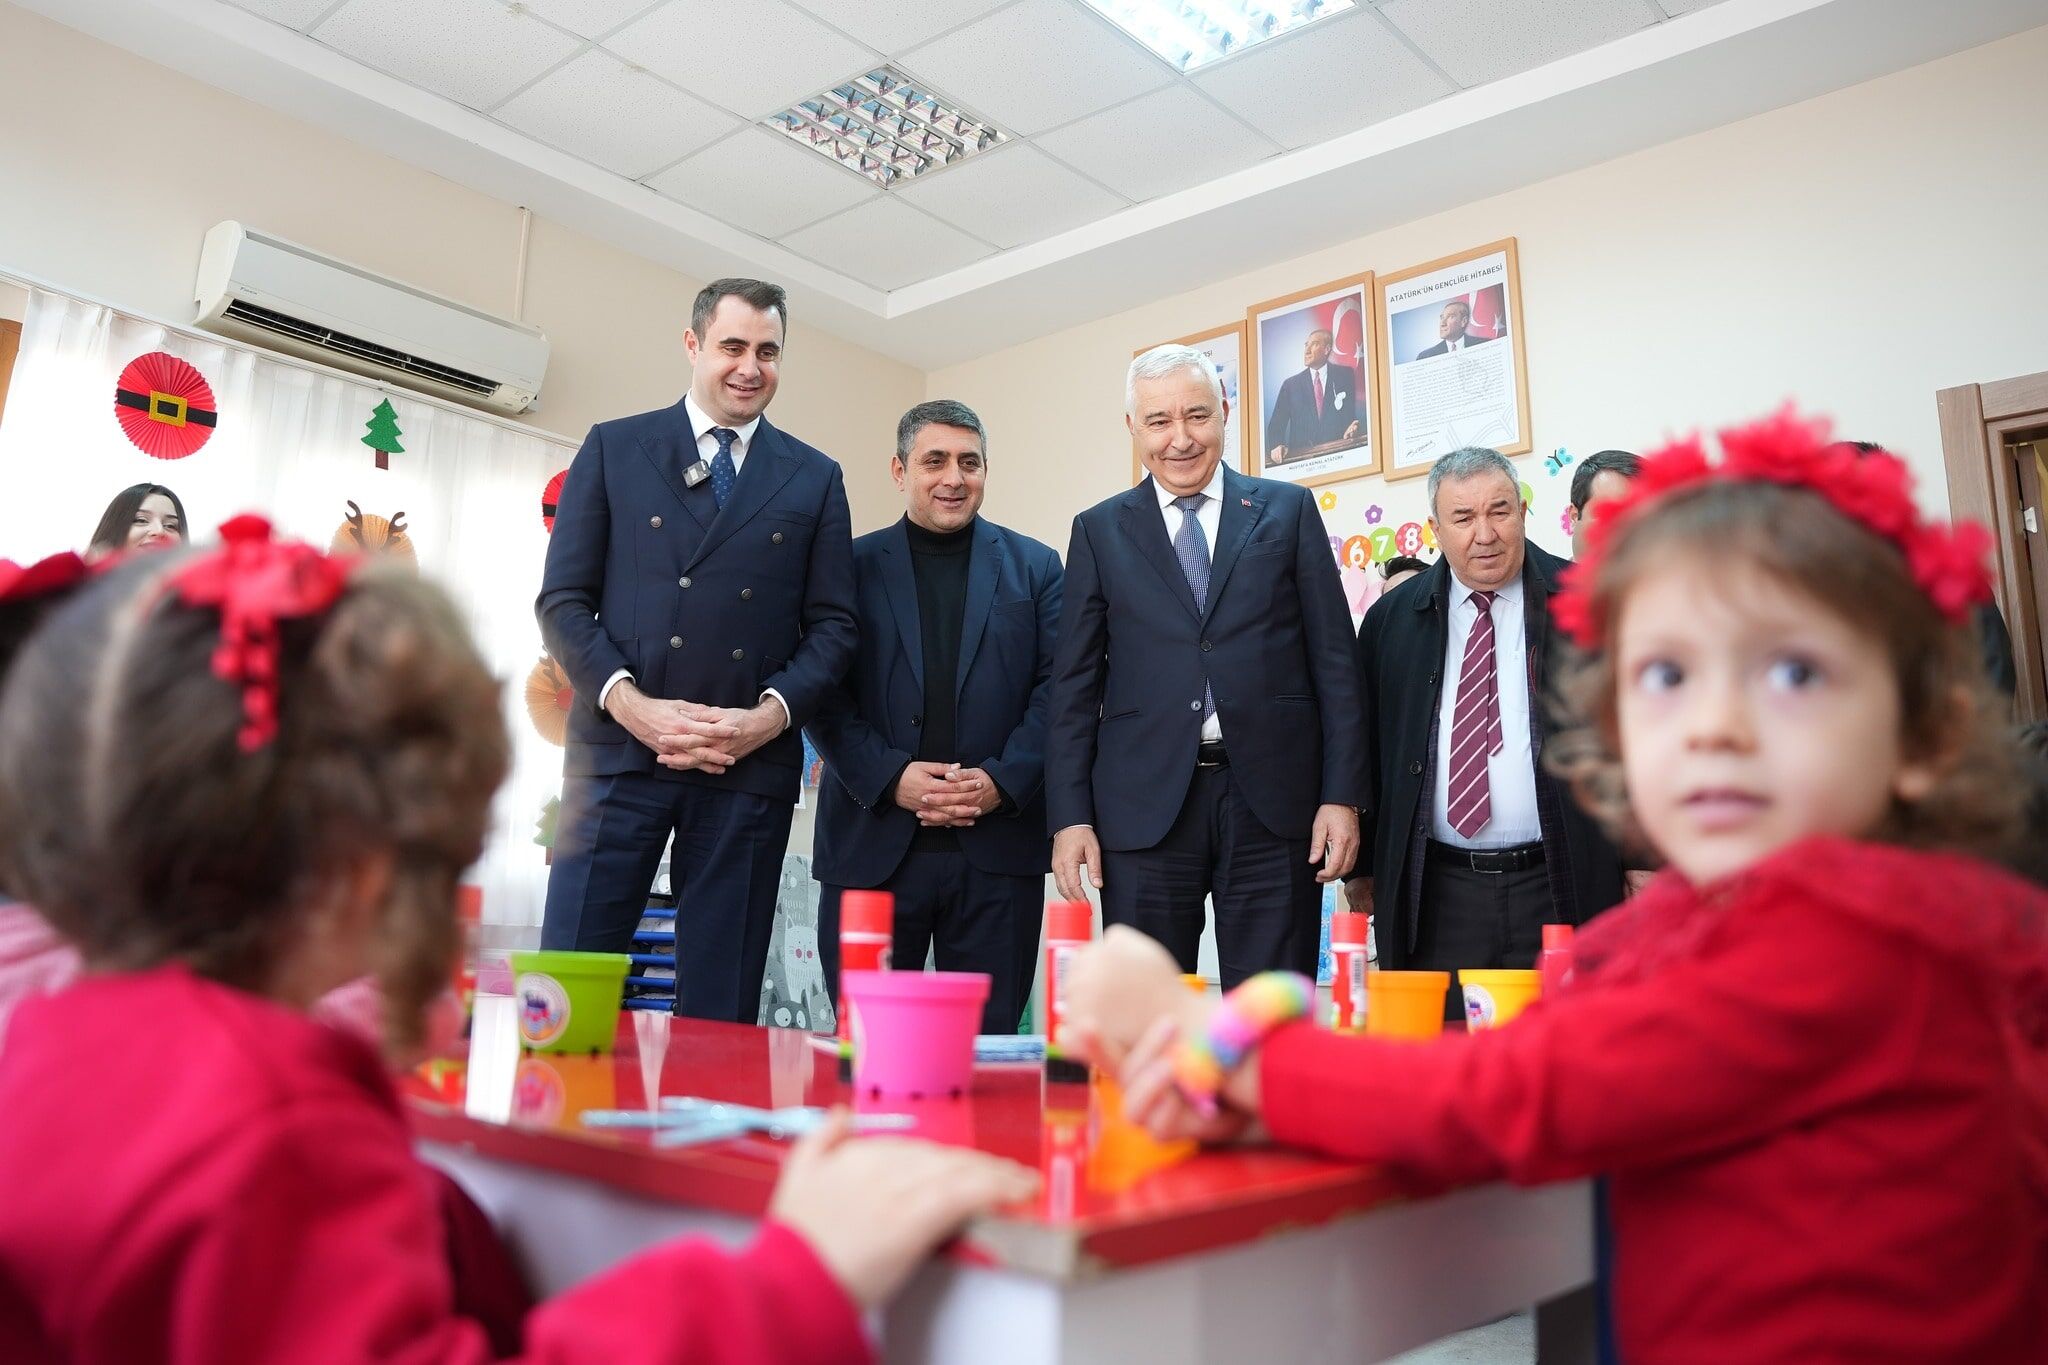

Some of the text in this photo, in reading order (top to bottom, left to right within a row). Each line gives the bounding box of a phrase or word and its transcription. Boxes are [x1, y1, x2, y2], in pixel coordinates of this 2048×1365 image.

[1390, 263, 1503, 303] ATATÜRK'ÜN GENÇLİĞE HİTABESİ
[1349, 540, 1365, 567] 6
[1375, 534, 1390, 557] 7
[1404, 527, 1418, 551] 8
